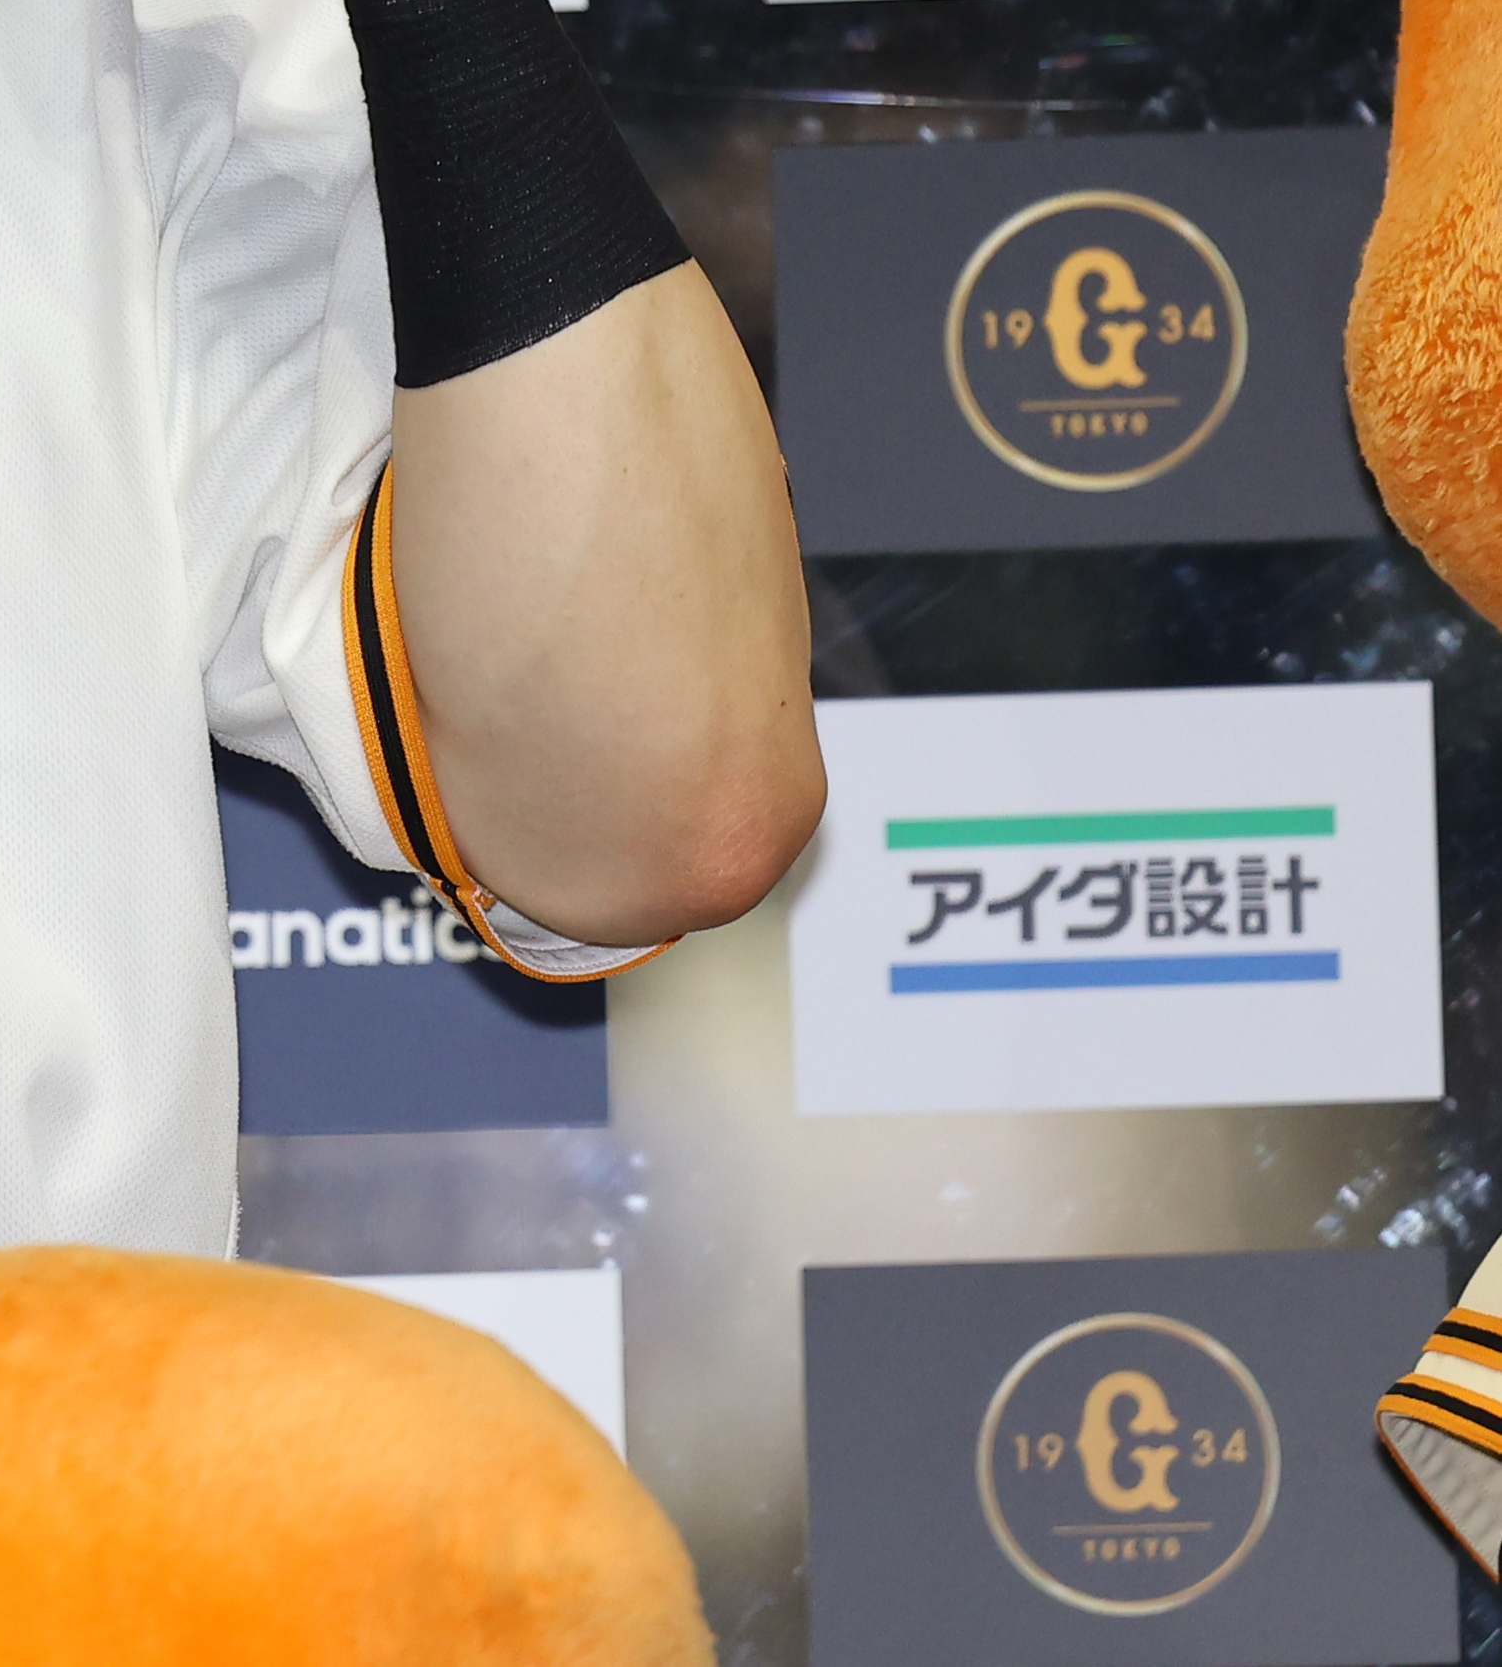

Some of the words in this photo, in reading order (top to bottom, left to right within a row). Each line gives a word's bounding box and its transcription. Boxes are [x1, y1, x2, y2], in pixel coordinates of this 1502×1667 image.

[981, 308, 1035, 349] 19
[1043, 246, 1148, 390] G
[1156, 302, 1217, 345] 34
[229, 886, 506, 968] anatic
[904, 854, 1320, 944] アイダ設計
[1013, 1432, 1066, 1471] 19
[1075, 1369, 1180, 1513] G
[1190, 1428, 1249, 1467] 34
